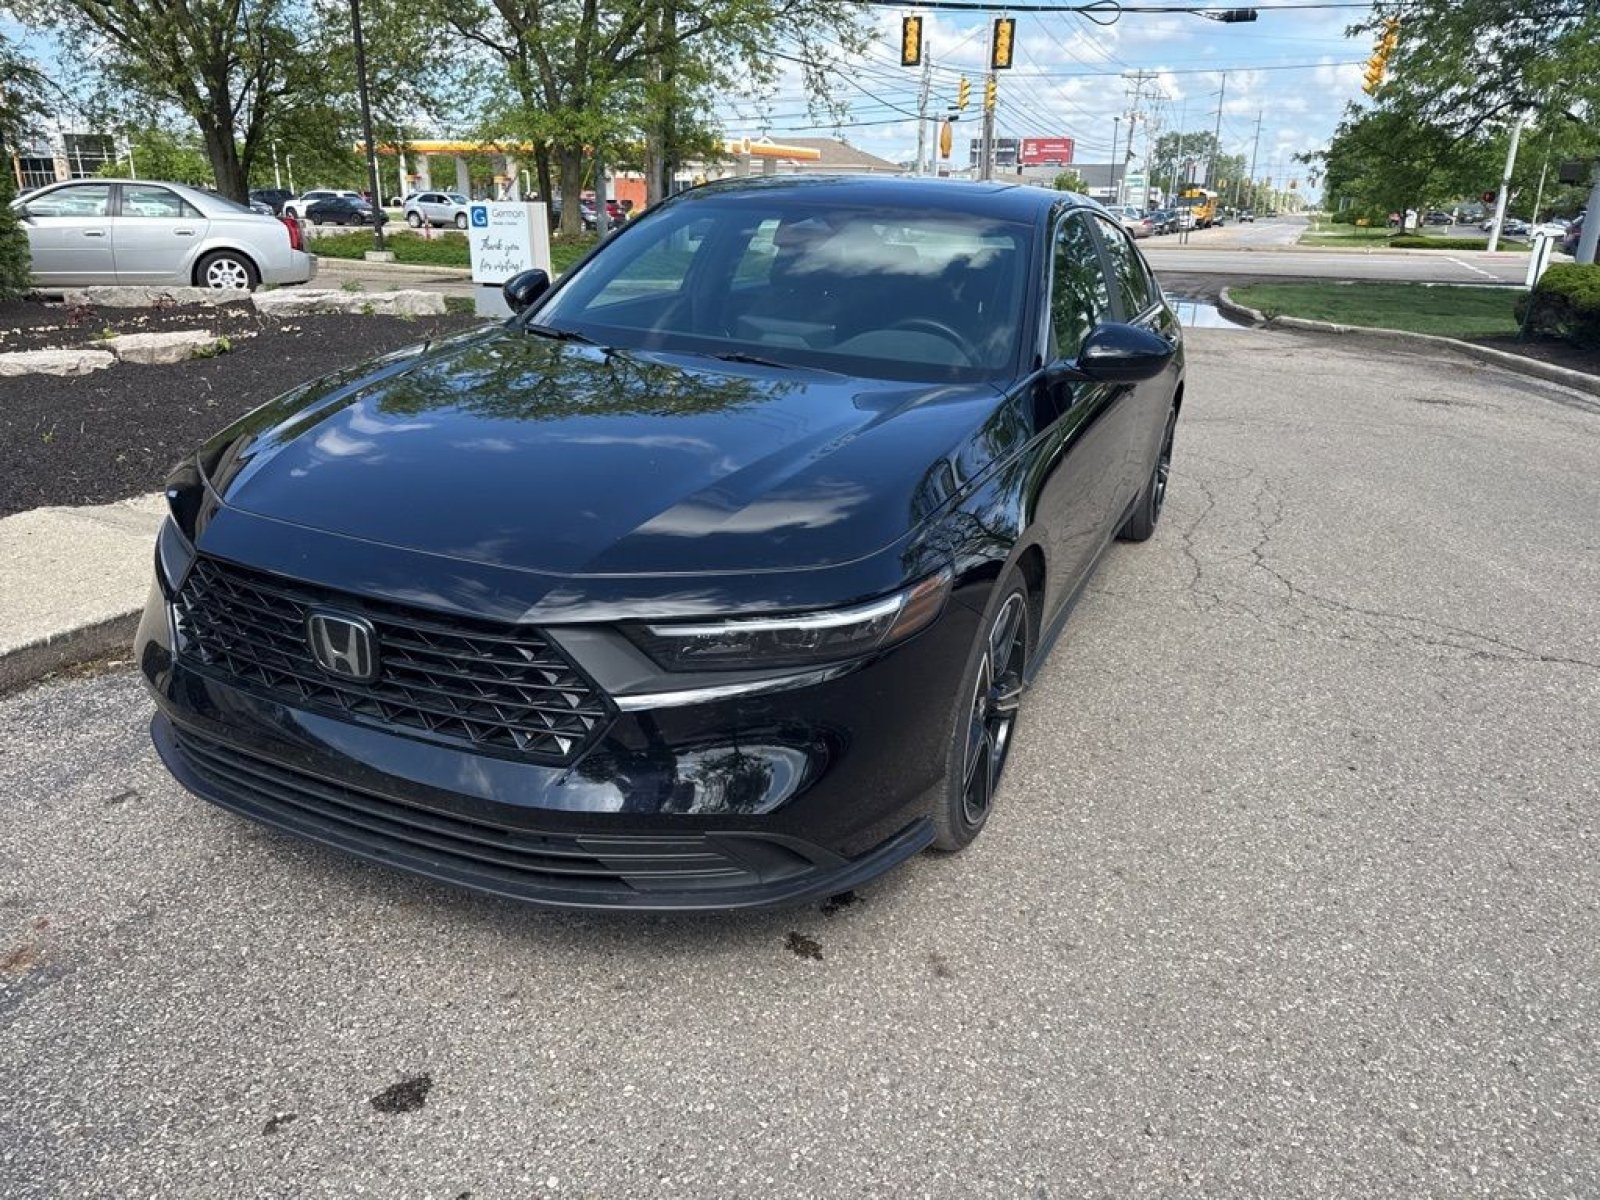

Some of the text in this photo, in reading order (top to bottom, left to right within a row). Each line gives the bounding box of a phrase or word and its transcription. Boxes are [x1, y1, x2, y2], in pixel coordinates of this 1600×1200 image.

[473, 208, 486, 226] G
[480, 235, 520, 256] Thank you
